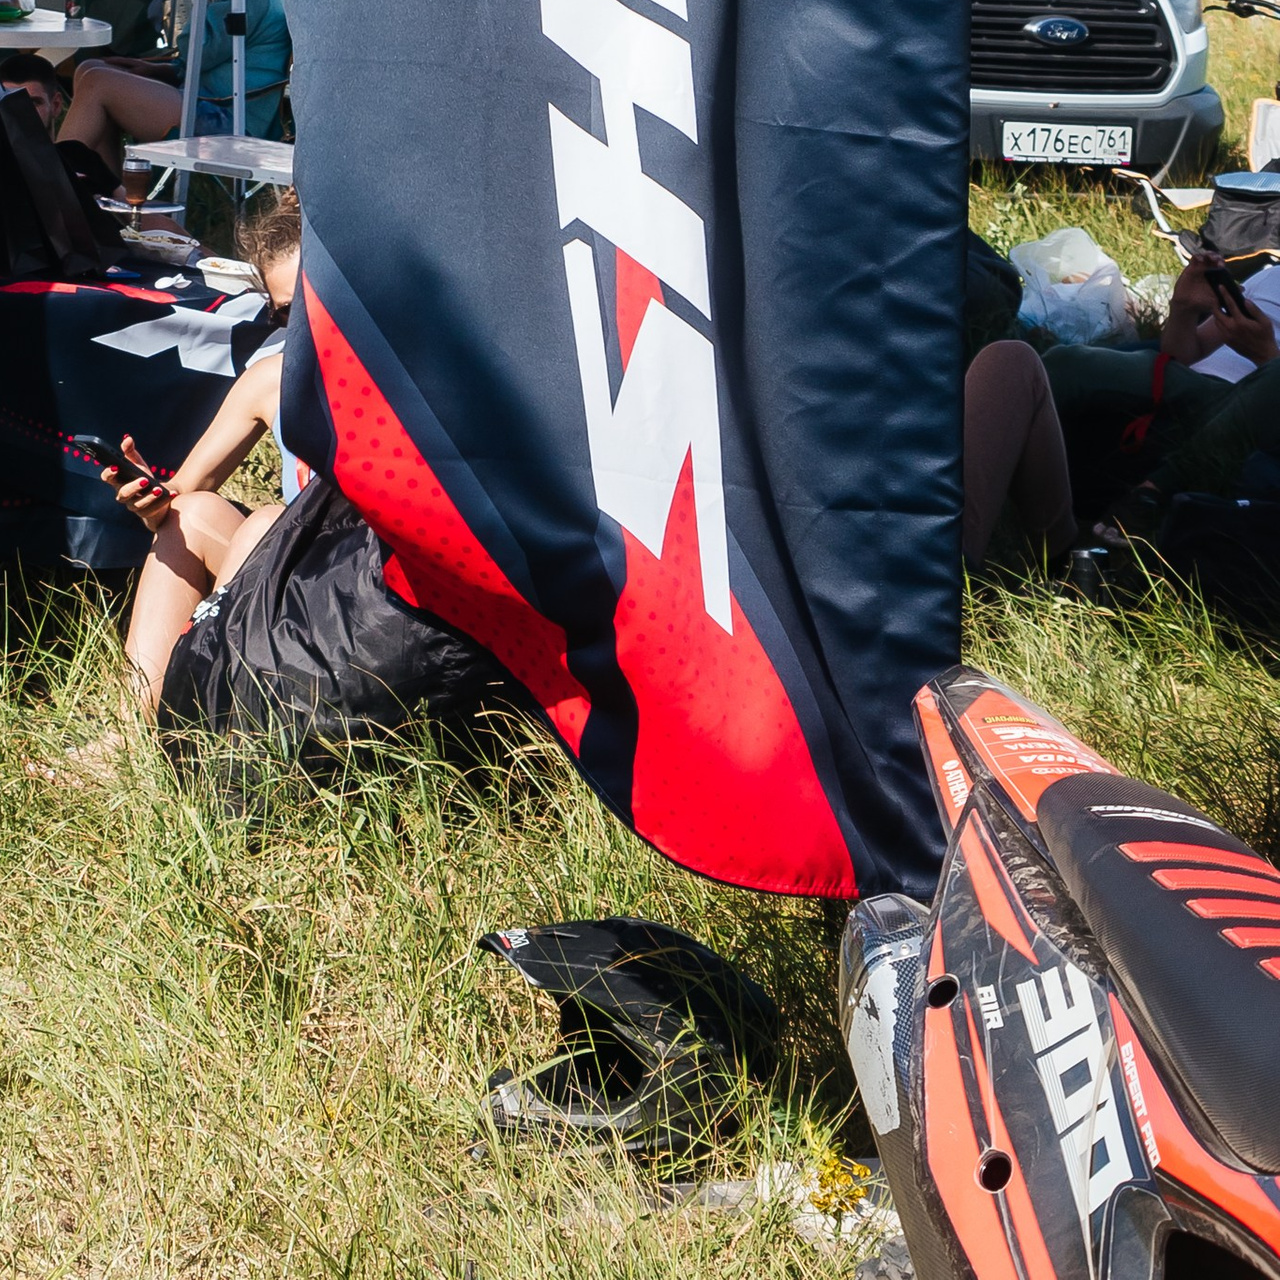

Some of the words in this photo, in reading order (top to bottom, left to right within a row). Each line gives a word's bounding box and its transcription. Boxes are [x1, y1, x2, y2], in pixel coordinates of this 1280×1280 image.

[1047, 23, 1079, 40] Ford
[1097, 129, 1127, 150] 761
[944, 768, 970, 808] ATHENA
[977, 984, 1005, 1030] AIR
[1120, 1042, 1148, 1118] EXPERT
[1141, 1121, 1162, 1169] PRO
